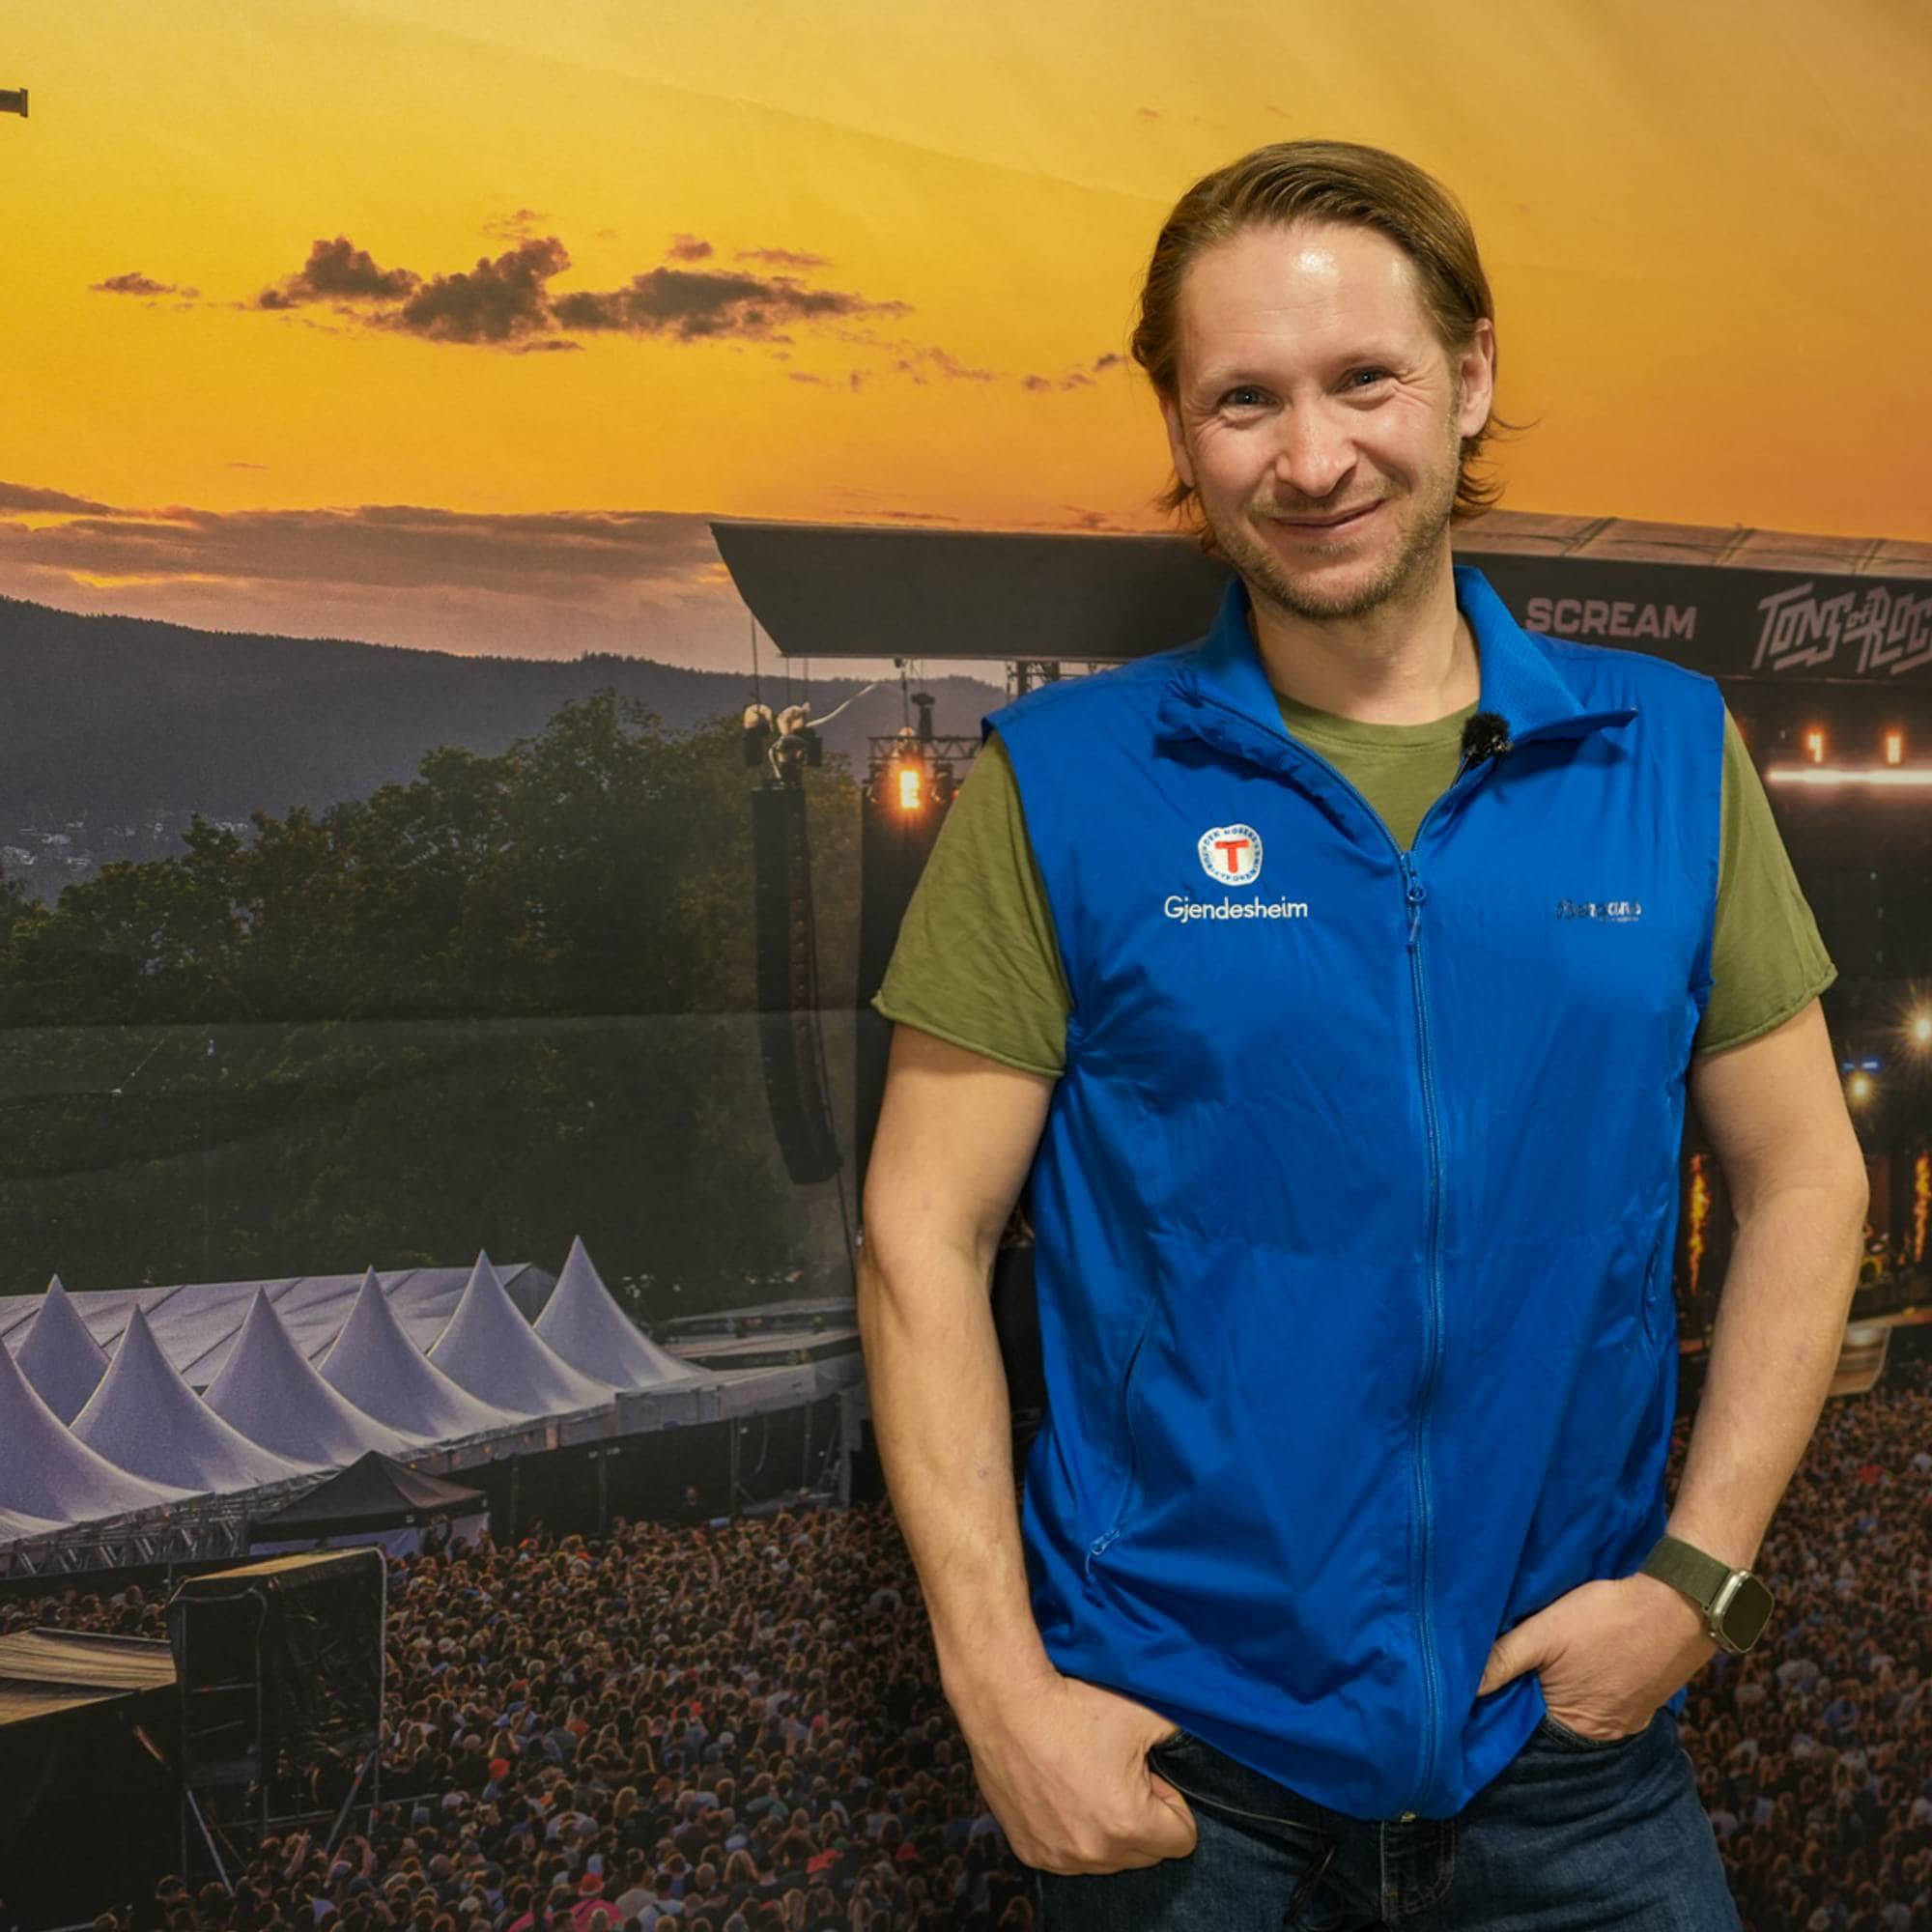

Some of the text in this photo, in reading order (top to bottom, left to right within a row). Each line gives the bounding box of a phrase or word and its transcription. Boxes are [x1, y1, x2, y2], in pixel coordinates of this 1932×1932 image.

[1525, 597, 1697, 639] SCREAM
[1842, 585, 1932, 675] ROC
[1215, 838, 1249, 873] T
[1164, 895, 1308, 923] Gjendesheim
